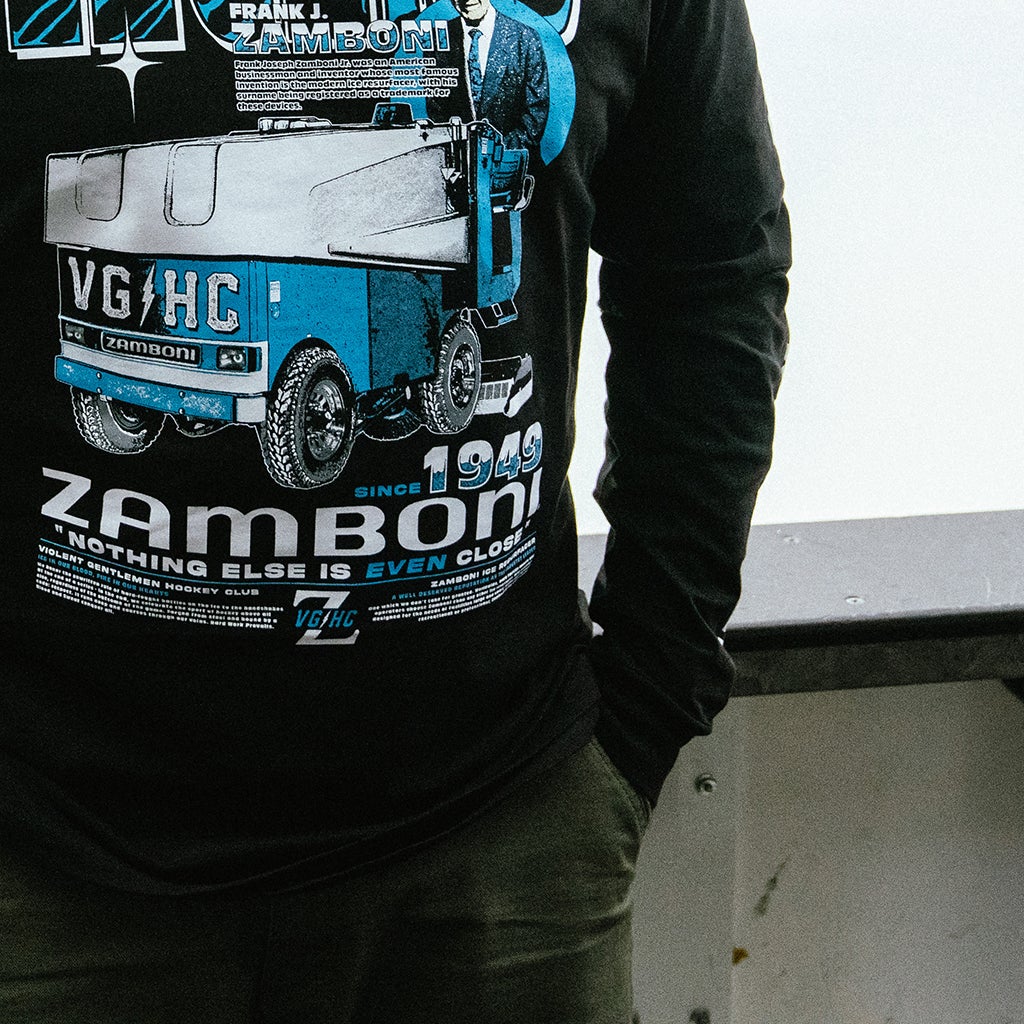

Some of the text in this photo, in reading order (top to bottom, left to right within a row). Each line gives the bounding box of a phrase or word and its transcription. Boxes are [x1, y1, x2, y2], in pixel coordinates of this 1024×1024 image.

[229, 3, 329, 20] FRANK J.
[231, 20, 451, 55] ZAMBONI
[234, 57, 436, 70] Frank Joseph Zamboni Jr. was an American
[235, 67, 459, 79] businessman and inventor whose most famous
[236, 77, 458, 90] invention is the modern ice resurfacer, with his
[236, 92, 277, 101] surname
[278, 90, 305, 102] being
[305, 89, 357, 101] registered
[357, 90, 370, 98] as
[380, 88, 434, 98] trademark
[434, 88, 451, 97] for
[237, 101, 303, 112] these devices.
[105, 336, 196, 361] ZAMBONI
[354, 421, 543, 498] SINCE 1949
[41, 467, 543, 557] ZAMBONI
[38, 544, 84, 565] VIOLENT
[87, 559, 160, 588] GENTLEMEN
[165, 582, 219, 595] HOCKEY
[221, 563, 306, 579] ELSE
[320, 563, 351, 579] IS
[365, 554, 447, 579] EVEN
[430, 571, 480, 588] ZAMBONI
[482, 564, 497, 576] ICE
